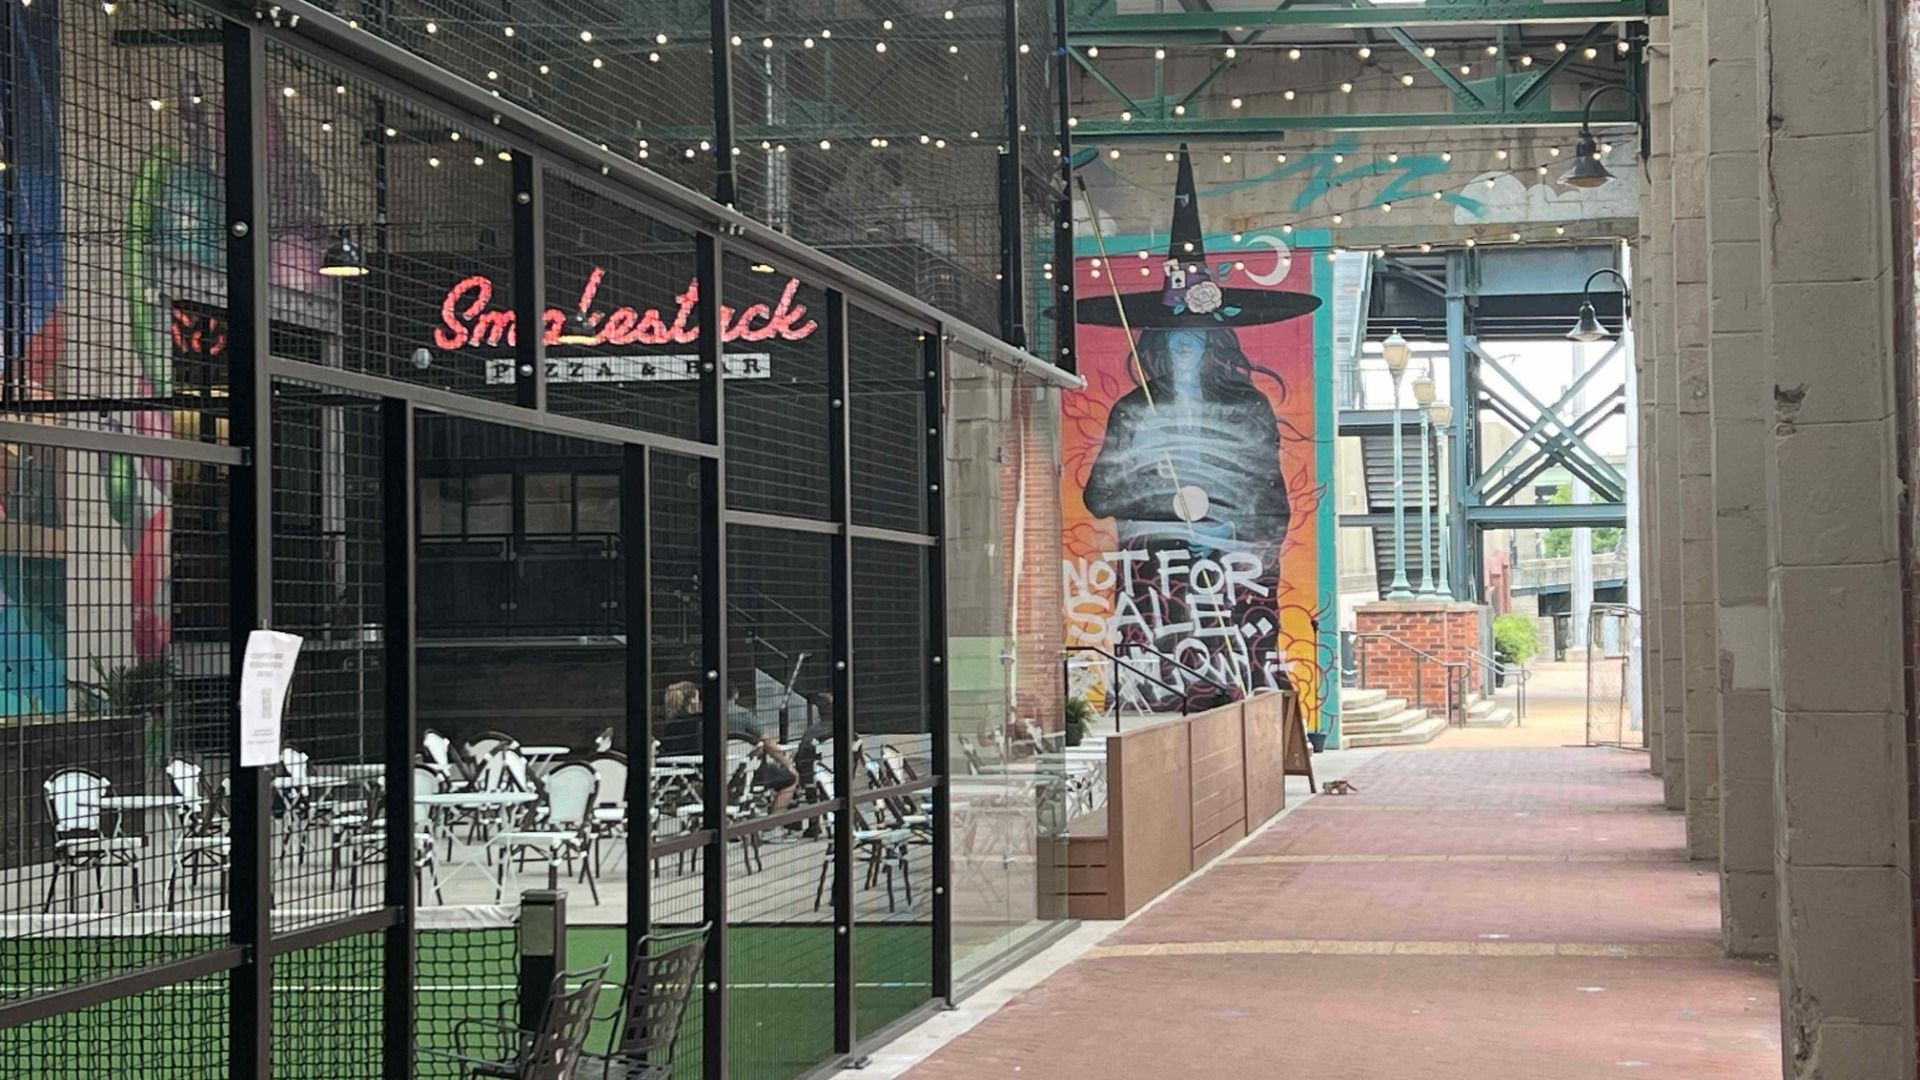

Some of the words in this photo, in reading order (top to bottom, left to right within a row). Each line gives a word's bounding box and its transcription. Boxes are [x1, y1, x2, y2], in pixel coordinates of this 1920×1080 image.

[494, 362, 615, 379] PZZA
[1062, 549, 1150, 606] NOT
[1154, 549, 1270, 606] FOR
